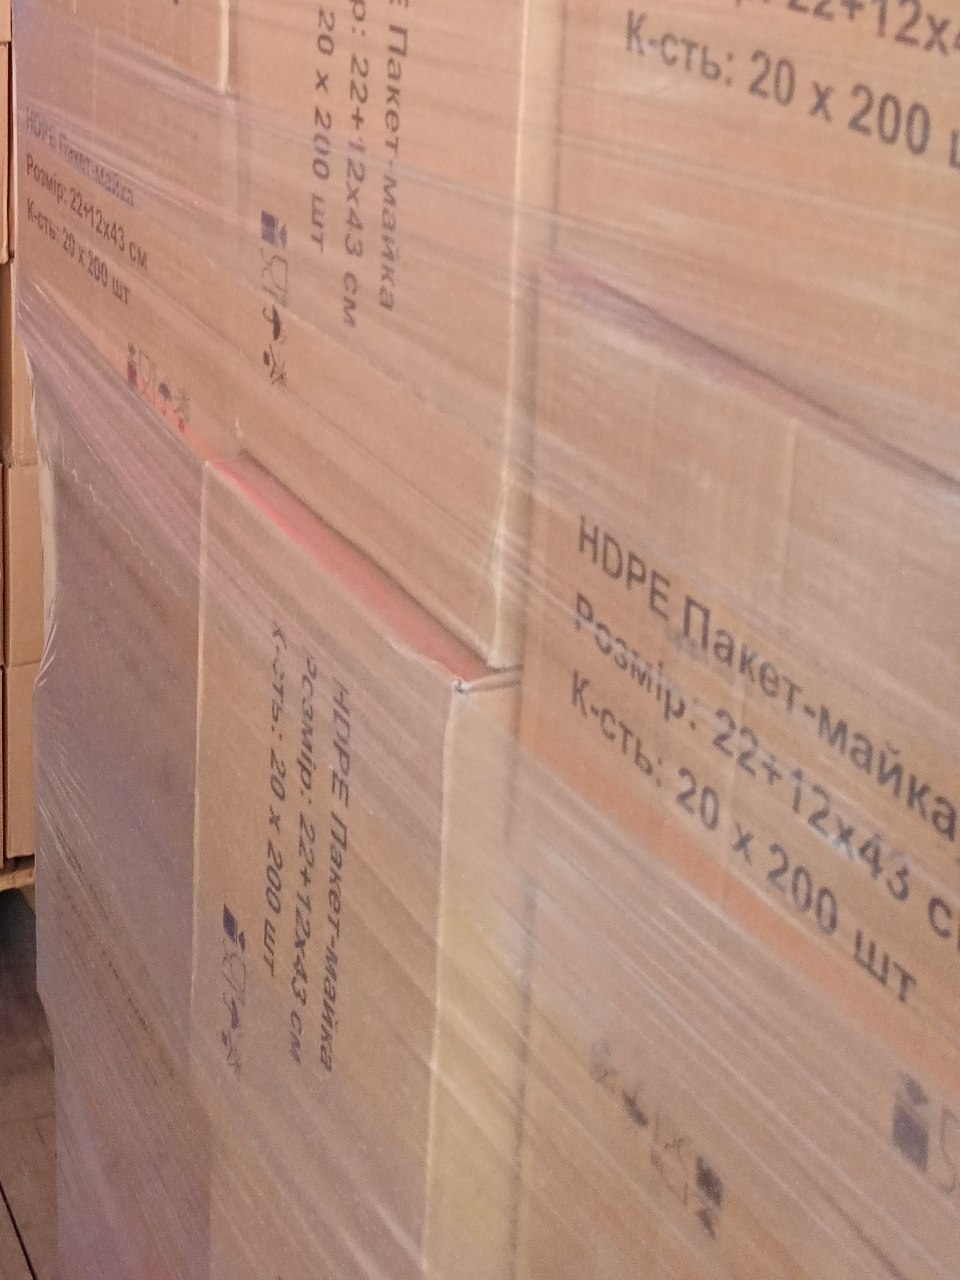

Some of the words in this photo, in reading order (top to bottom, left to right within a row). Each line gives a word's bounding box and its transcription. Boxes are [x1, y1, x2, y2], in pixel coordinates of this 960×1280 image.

[317, 8, 335, 56] 20
[625, 8, 734, 87] К-сть:
[747, 49, 797, 107] 20
[847, 82, 931, 156] 200
[311, 105, 333, 182] 200
[377, 22, 409, 313] Пакет-майка
[26, 152, 68, 205] Розмір:
[128, 240, 148, 271] см
[26, 197, 59, 241] К-сть:
[62, 227, 76, 258] 20
[87, 248, 108, 288] 200
[111, 275, 130, 306] шт
[310, 195, 325, 254] шт
[341, 270, 357, 329] см
[577, 514, 672, 622] HDPE
[681, 594, 957, 844] Пакет-майка
[269, 745, 286, 802] 20
[330, 675, 351, 809] HDPE
[574, 591, 698, 732] Розмір:
[928, 895, 960, 952] с
[263, 836, 284, 915] 200
[570, 668, 664, 788] К-сть:
[674, 766, 721, 831] 20
[764, 842, 840, 938] 200
[853, 929, 918, 1004] шт
[262, 916, 277, 978] шт
[319, 811, 348, 1073] Пакет-майка
[290, 1007, 302, 1065] см
